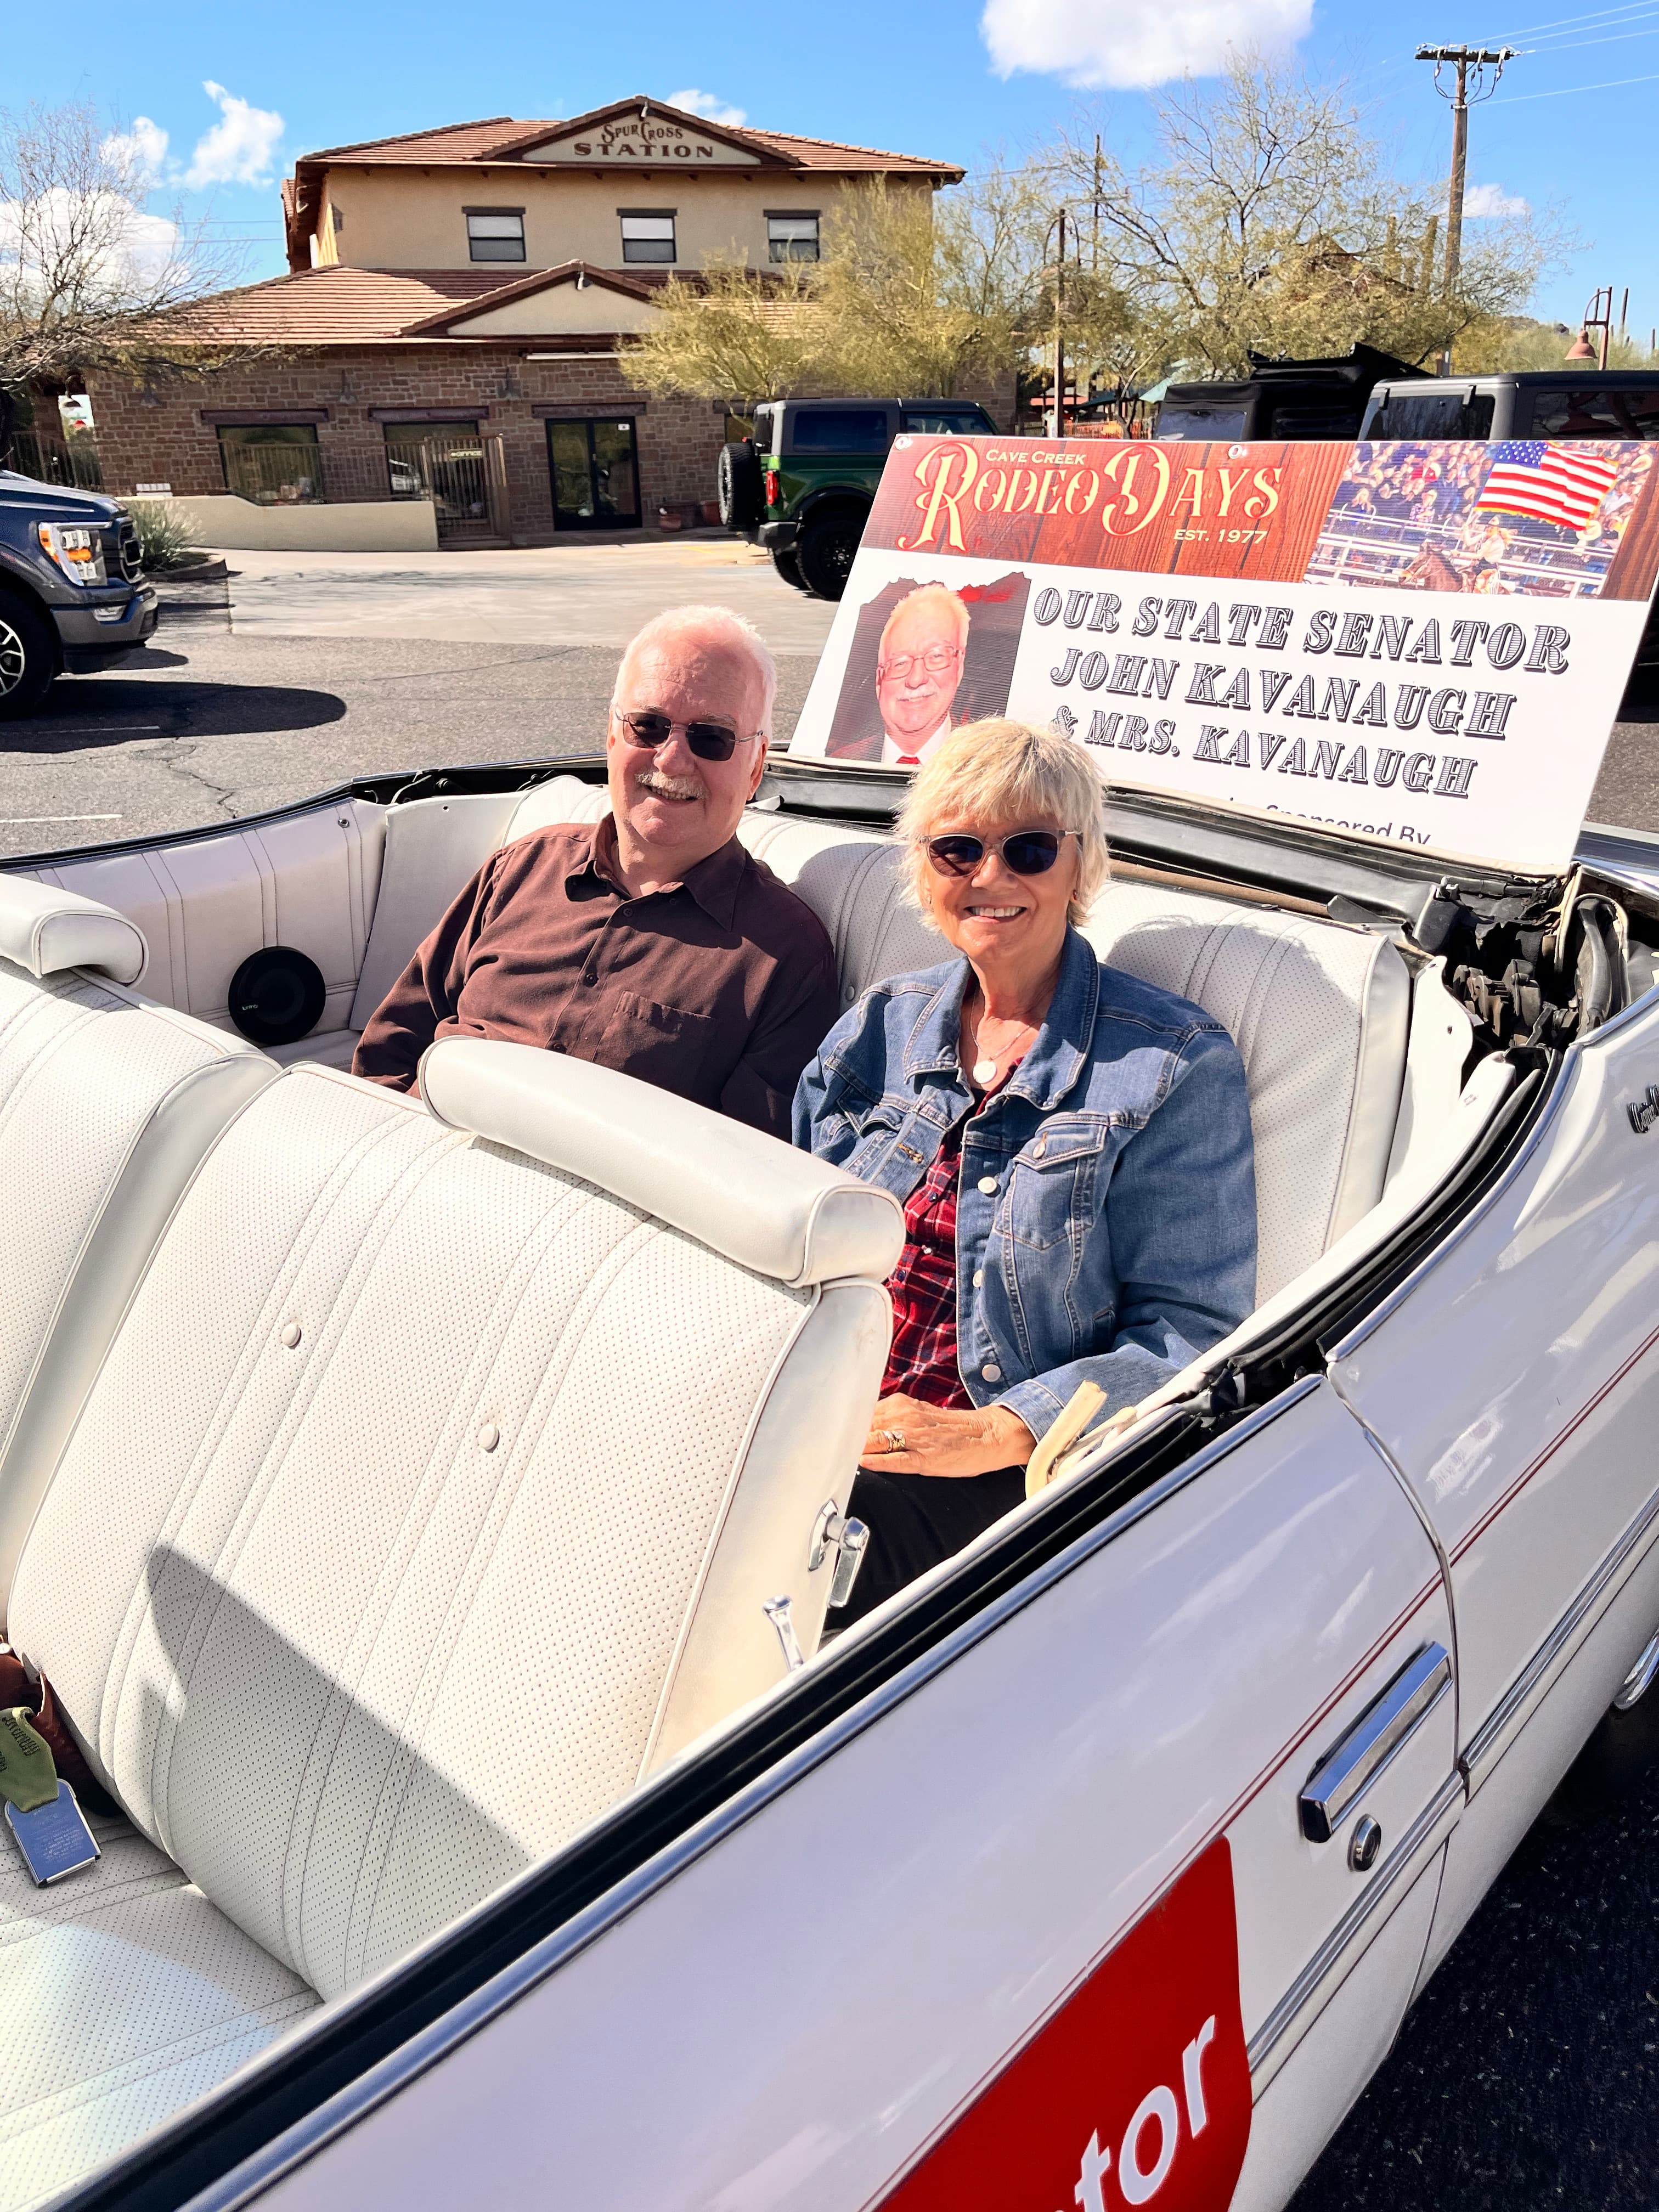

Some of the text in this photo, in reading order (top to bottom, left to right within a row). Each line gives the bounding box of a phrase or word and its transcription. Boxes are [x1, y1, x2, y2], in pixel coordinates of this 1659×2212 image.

[574, 143, 713, 157] STATION
[601, 122, 683, 144] SPUR CROSS
[897, 442, 1283, 551] RODEO DAYS
[986, 450, 1087, 465] CAVE CREEK
[1174, 529, 1267, 544] EST. 1977
[1034, 588, 1571, 675] OUR STATE SENATOR
[1050, 648, 1517, 740] JOHN KAVANAUGH
[1048, 706, 1478, 799] & MRS. KAVANAUGH
[1053, 2014, 1216, 2212] tor
